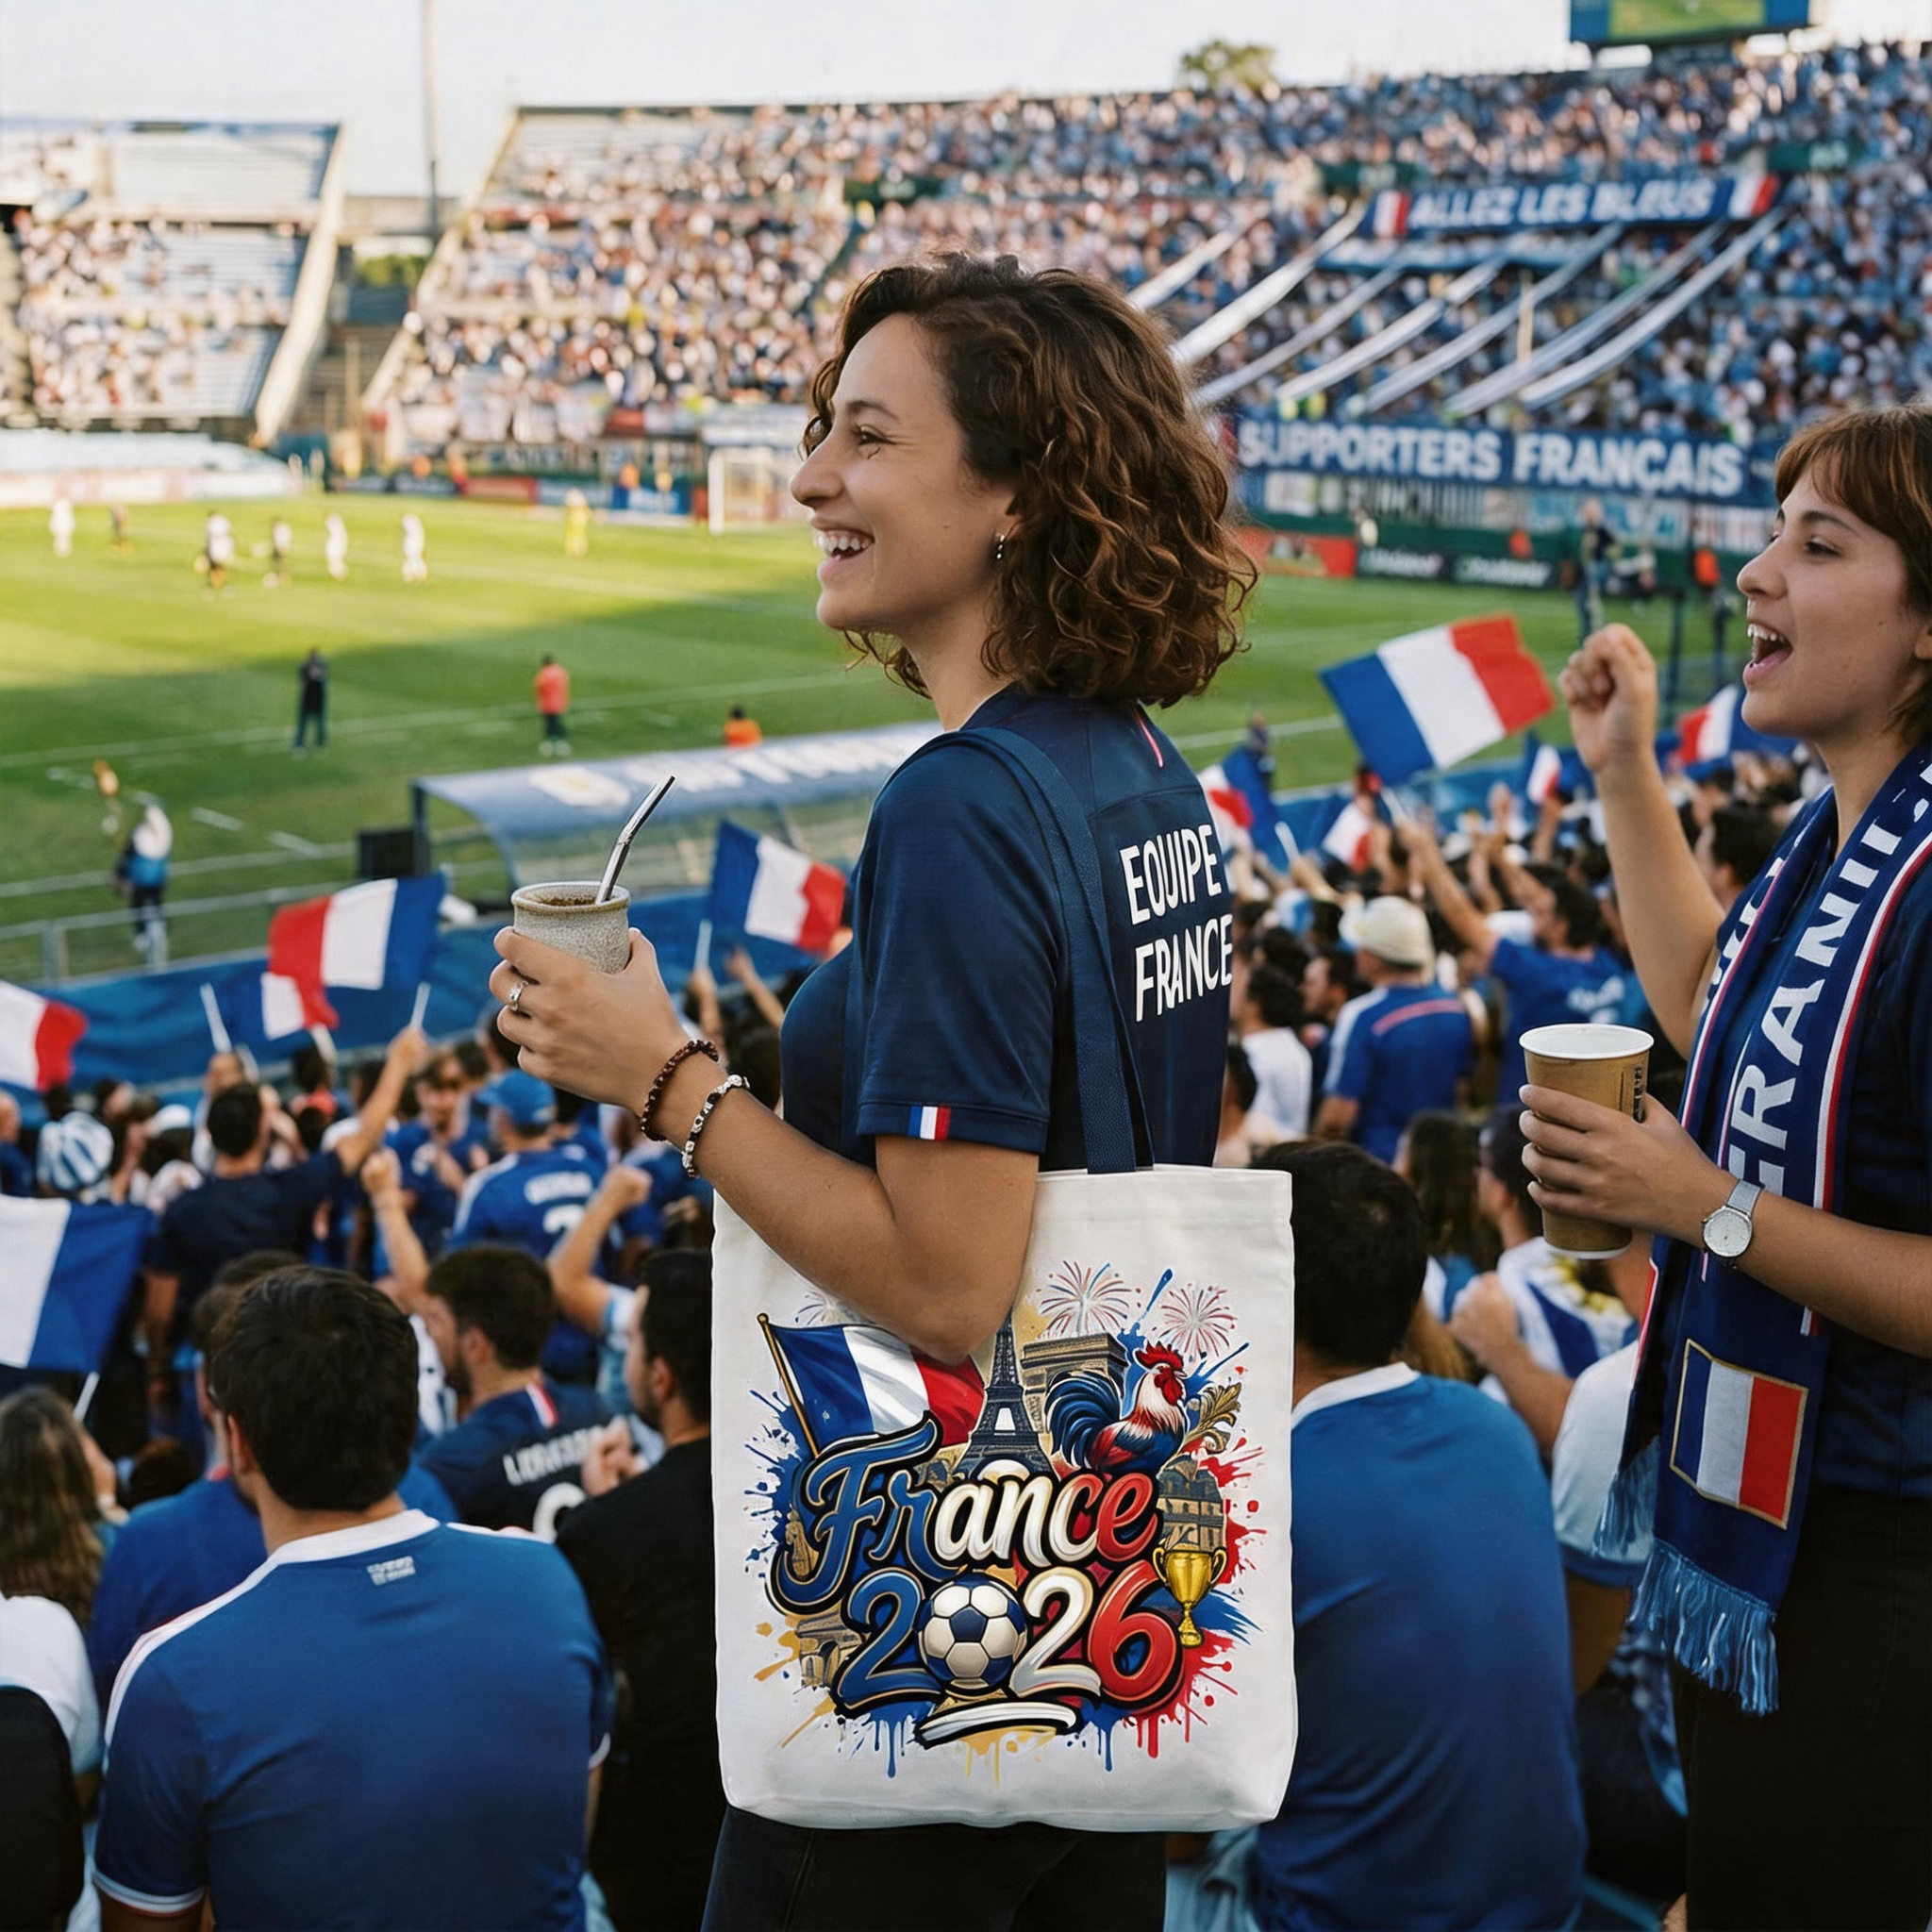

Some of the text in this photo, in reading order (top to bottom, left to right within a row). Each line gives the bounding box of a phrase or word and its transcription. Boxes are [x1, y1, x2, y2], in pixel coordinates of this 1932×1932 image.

[1408, 176, 1716, 227] ALLEZ LES BLEUS
[1237, 425, 1502, 481] SUPPORTERS
[1136, 913, 1233, 1023] FRANCE
[769, 1413, 1163, 1607] France
